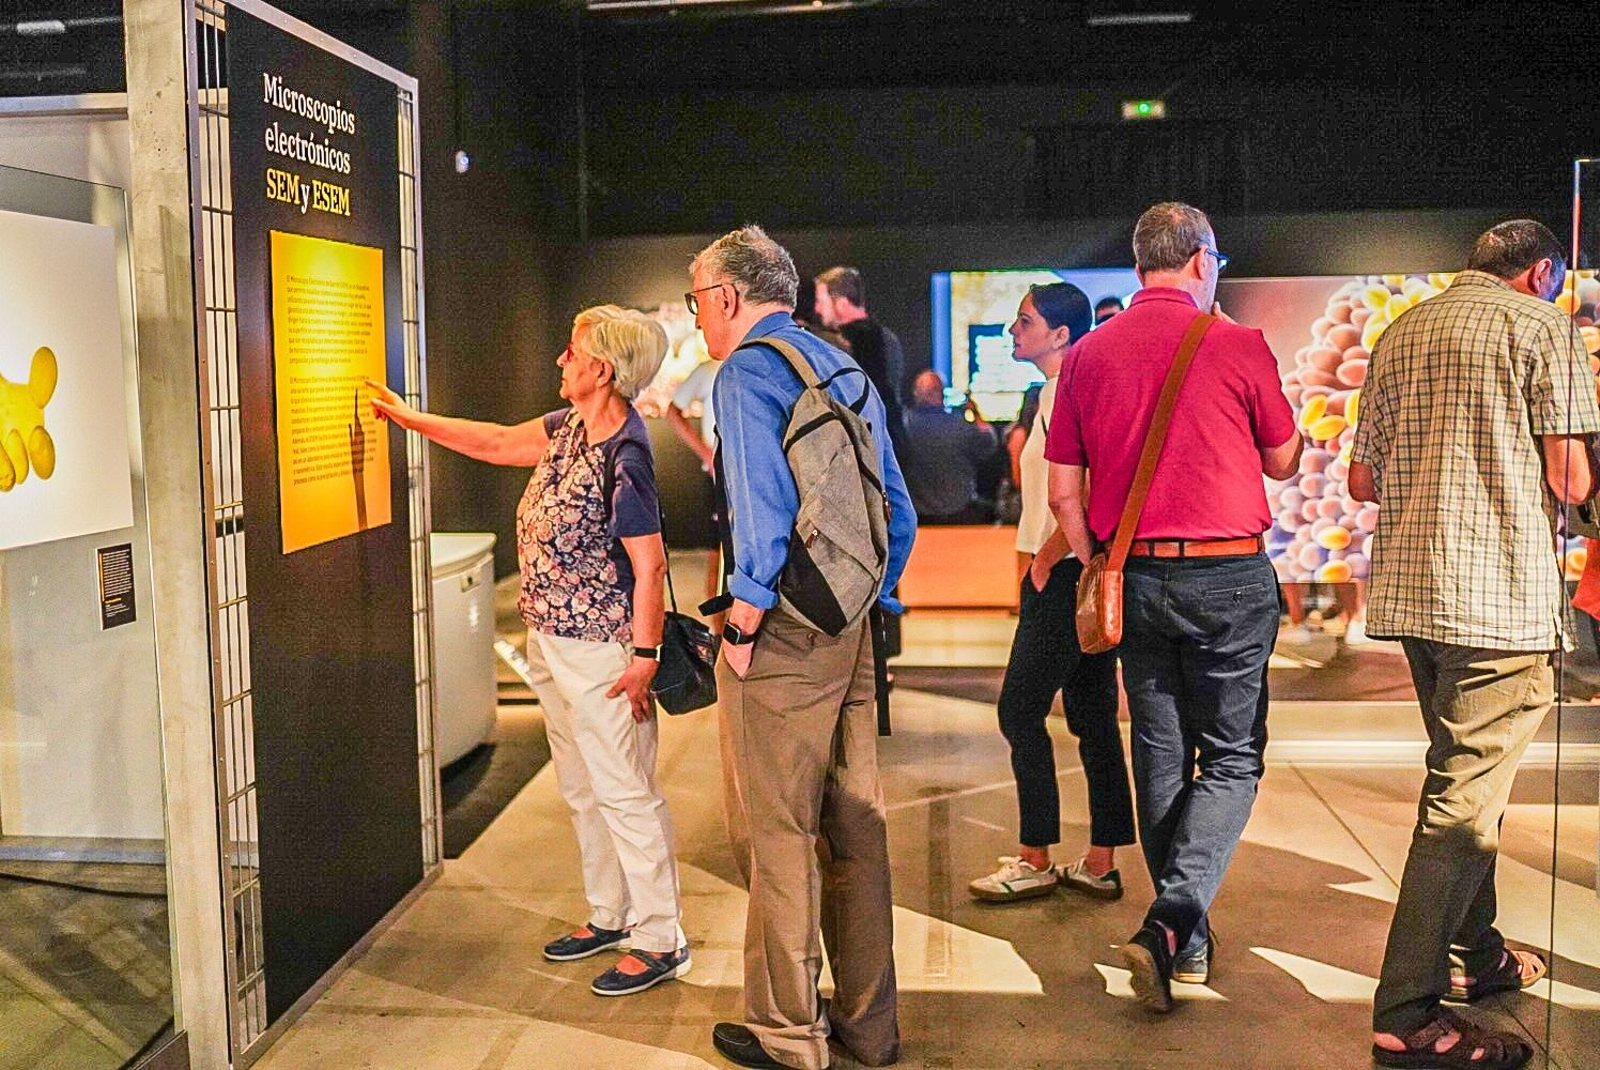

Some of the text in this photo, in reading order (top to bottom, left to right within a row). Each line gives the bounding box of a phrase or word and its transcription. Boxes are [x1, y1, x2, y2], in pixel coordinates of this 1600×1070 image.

[263, 73, 355, 134] Microscopios
[265, 122, 351, 173] electrónicos
[266, 168, 351, 216] SEM y ESEM
